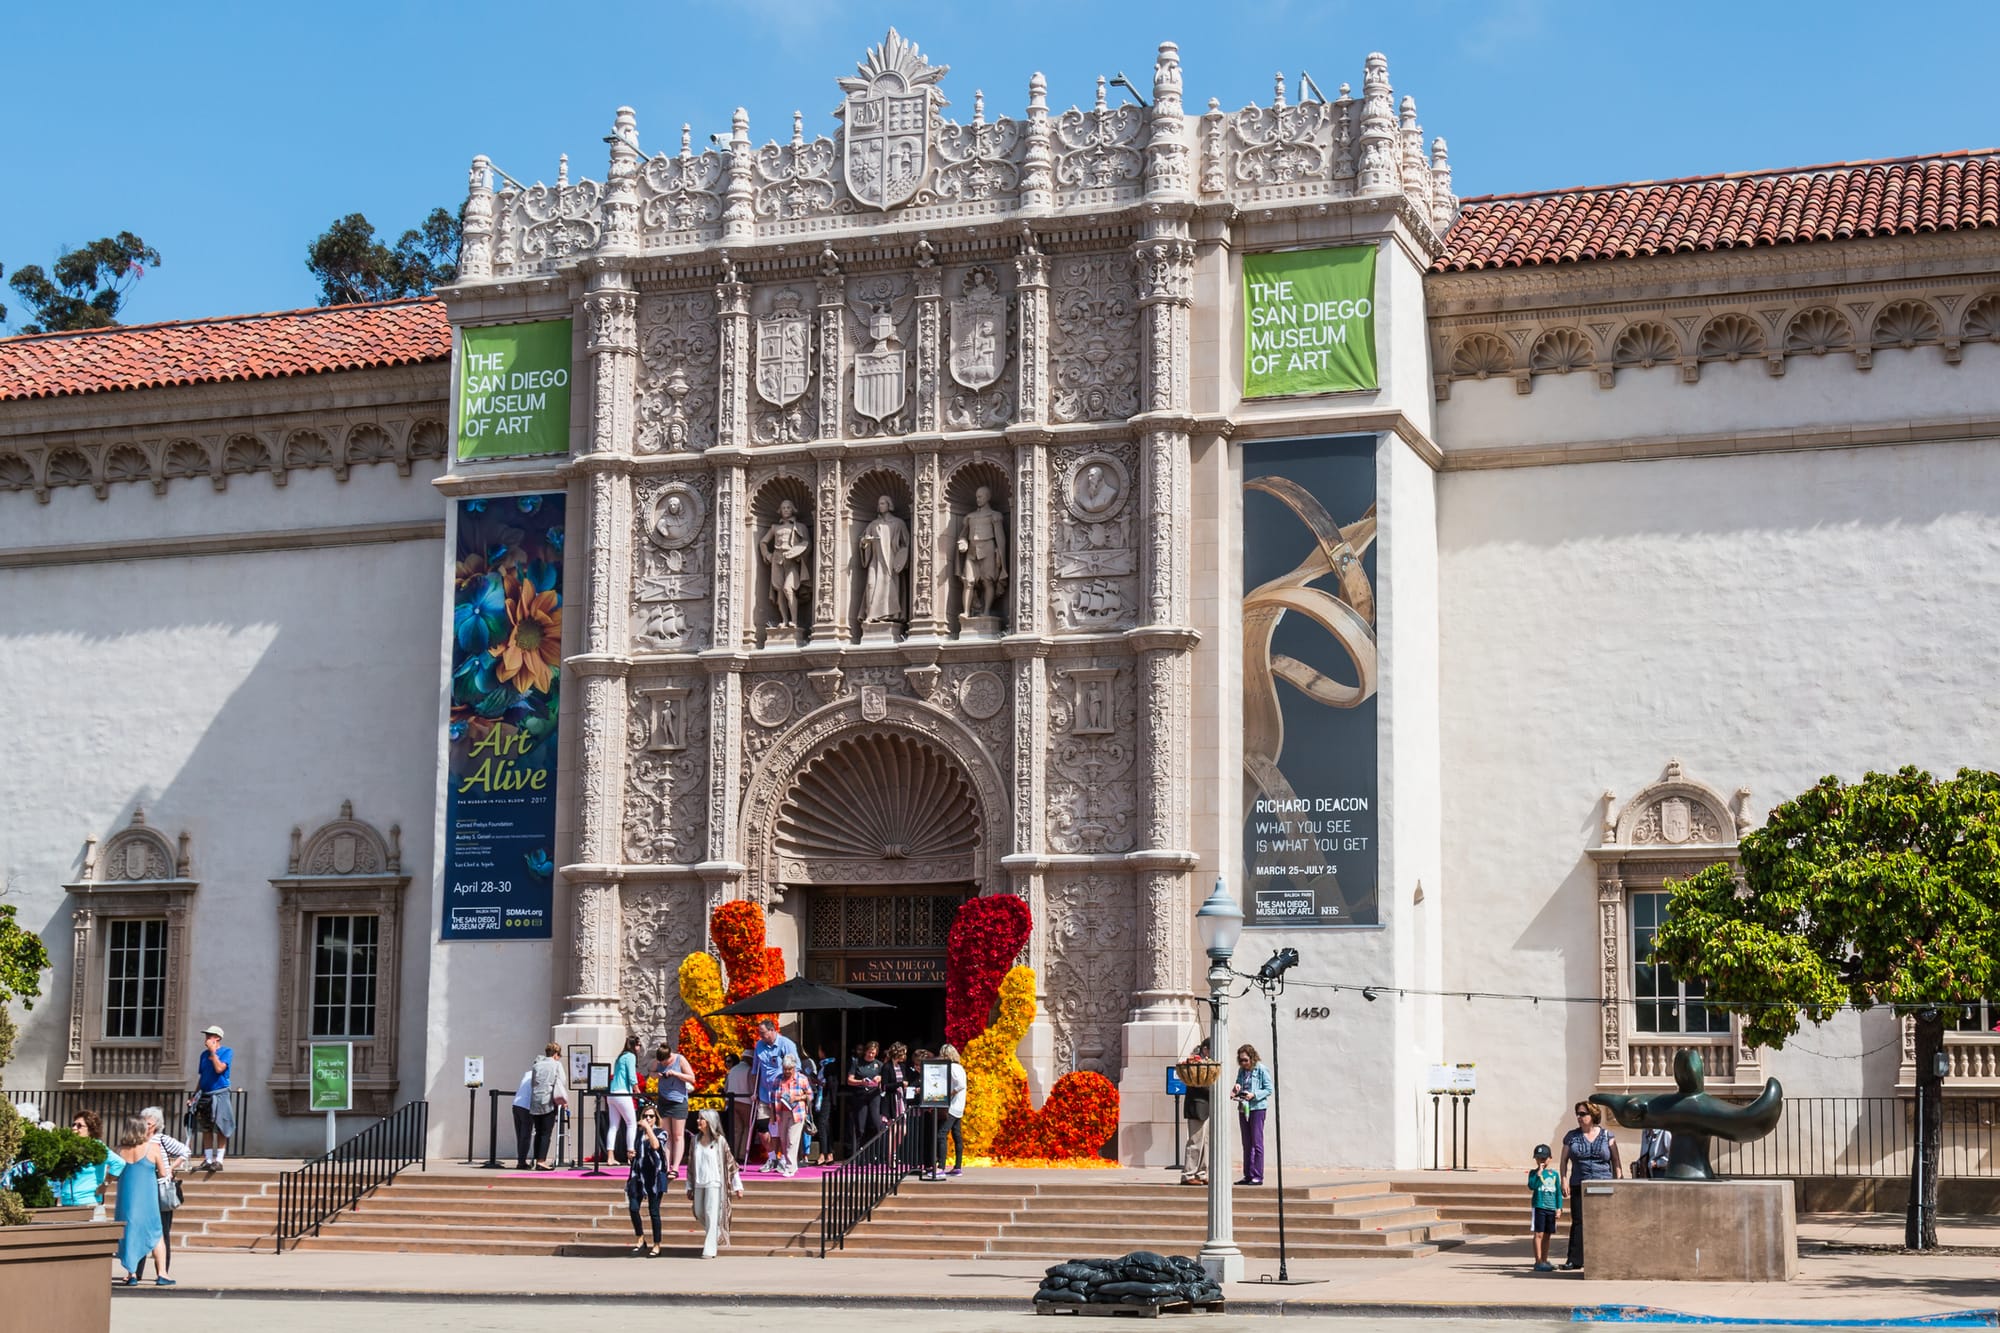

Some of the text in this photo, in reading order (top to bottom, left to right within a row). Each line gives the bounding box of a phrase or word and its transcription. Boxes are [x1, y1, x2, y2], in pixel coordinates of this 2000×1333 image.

[1250, 281, 1293, 303] THE
[1251, 298, 1372, 327] SAN DIEGO
[1251, 324, 1346, 351] MUSEUM
[468, 352, 504, 372] THE
[1251, 350, 1332, 375] OF ART
[467, 369, 568, 394] SAN DIEGO
[466, 392, 546, 416] MUSEUM
[465, 415, 533, 437] OF ART
[468, 722, 533, 758] Art
[458, 758, 547, 793] Alive
[530, 796, 547, 804] 2017
[1256, 797, 1368, 814] RICHARD DEACON
[1255, 819, 1352, 835] WHAT YOU SEE
[1256, 837, 1369, 853] IS WHAT YOU GET
[1256, 866, 1286, 875] MARCH
[1326, 865, 1337, 874] 25
[453, 881, 512, 896] April 28-30
[506, 908, 543, 917] SDMArt.org
[1256, 908, 1287, 916] MUSEUM
[1296, 907, 1312, 915] ART
[1257, 901, 1270, 909] THE
[1287, 900, 1309, 908] DIEGO
[868, 960, 936, 970] SAN DIEGO
[851, 971, 946, 982] MUSEUM OF AR
[1296, 1007, 1330, 1018] 1450
[316, 1069, 345, 1080] OPEN
